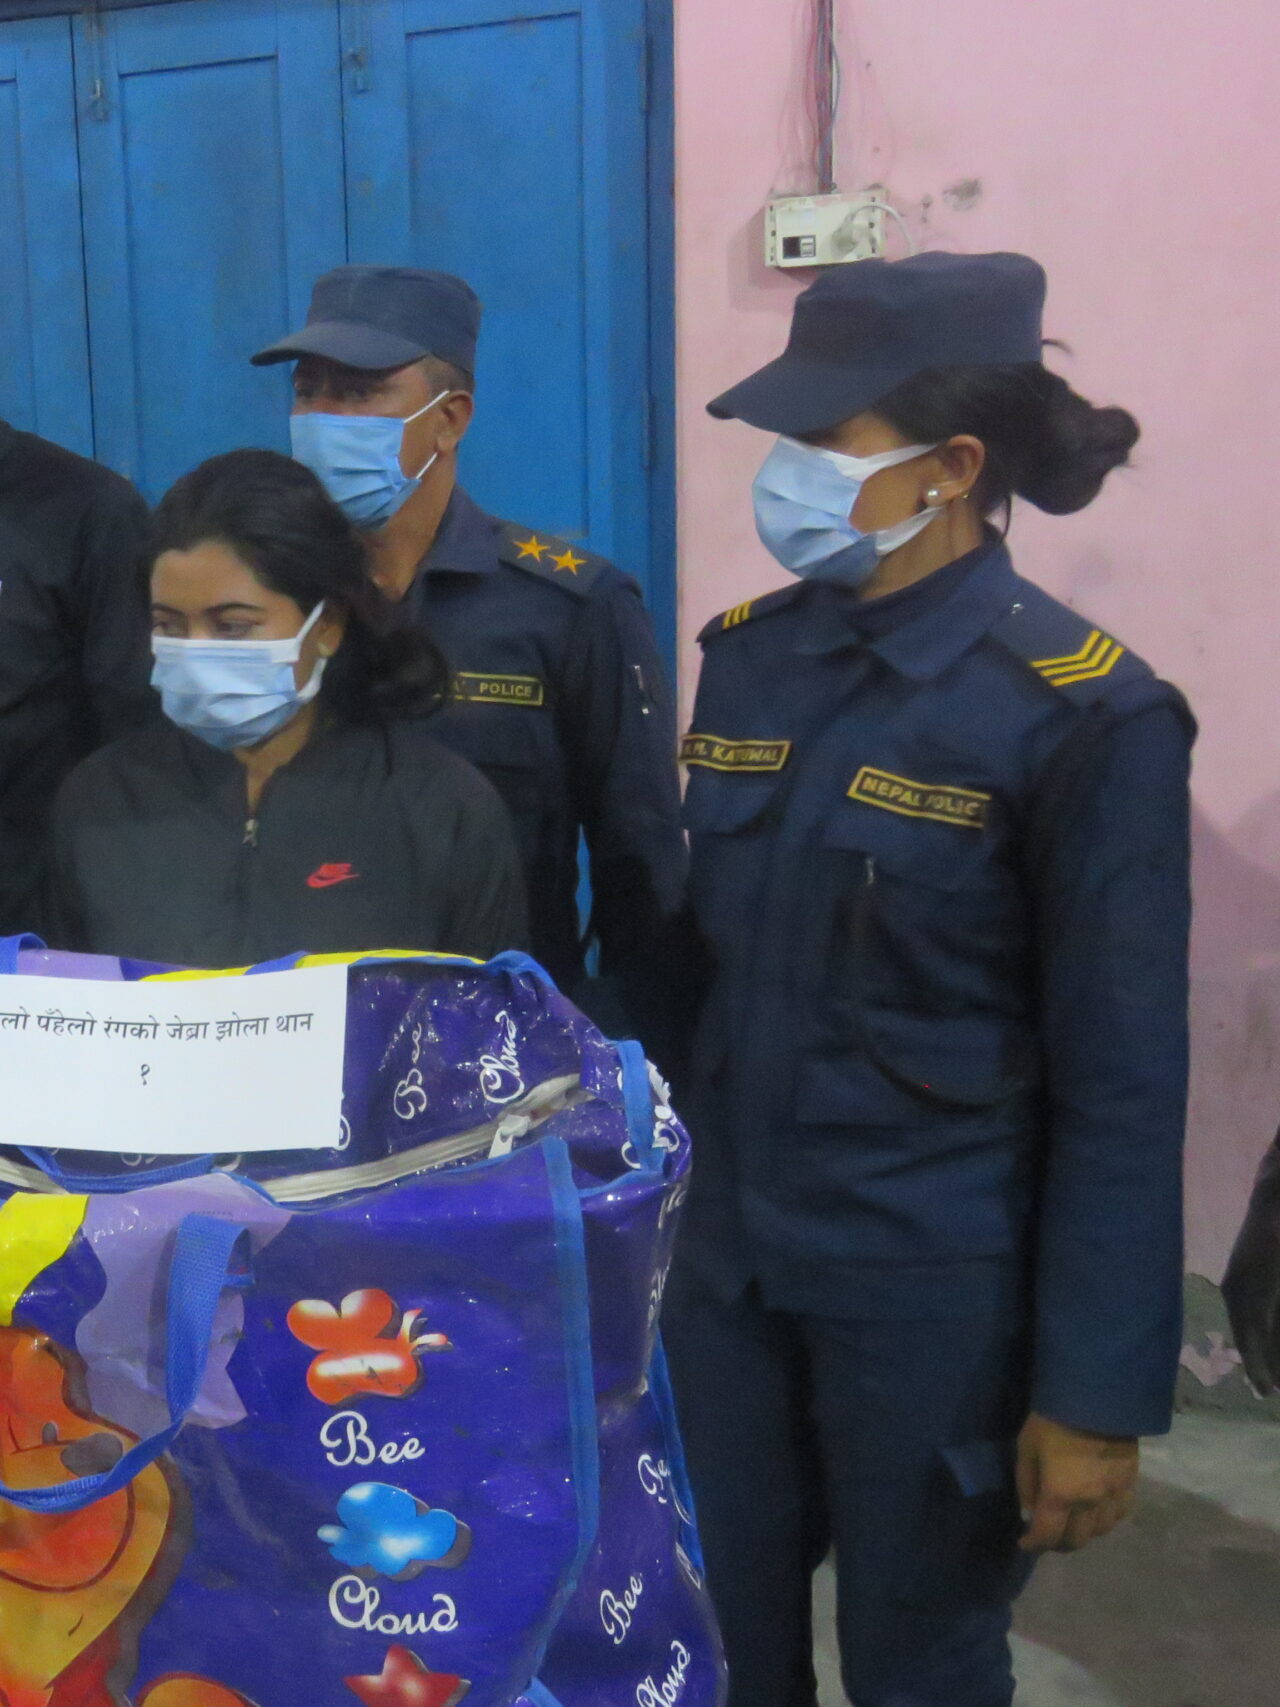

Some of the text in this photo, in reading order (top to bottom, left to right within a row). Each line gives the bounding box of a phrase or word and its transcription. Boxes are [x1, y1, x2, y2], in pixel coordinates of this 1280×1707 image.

[479, 682, 532, 697] POLICE
[861, 777, 980, 815] NEPAL POLIC
[104, 1014, 160, 1040] रंगको
[166, 1014, 210, 1041] जेब्रा
[216, 1011, 270, 1042] झोला
[276, 1012, 314, 1033] थान
[140, 1063, 151, 1086] १
[319, 1410, 426, 1467] Bee
[328, 1574, 459, 1636] Cloud
[600, 1574, 643, 1645] Bee
